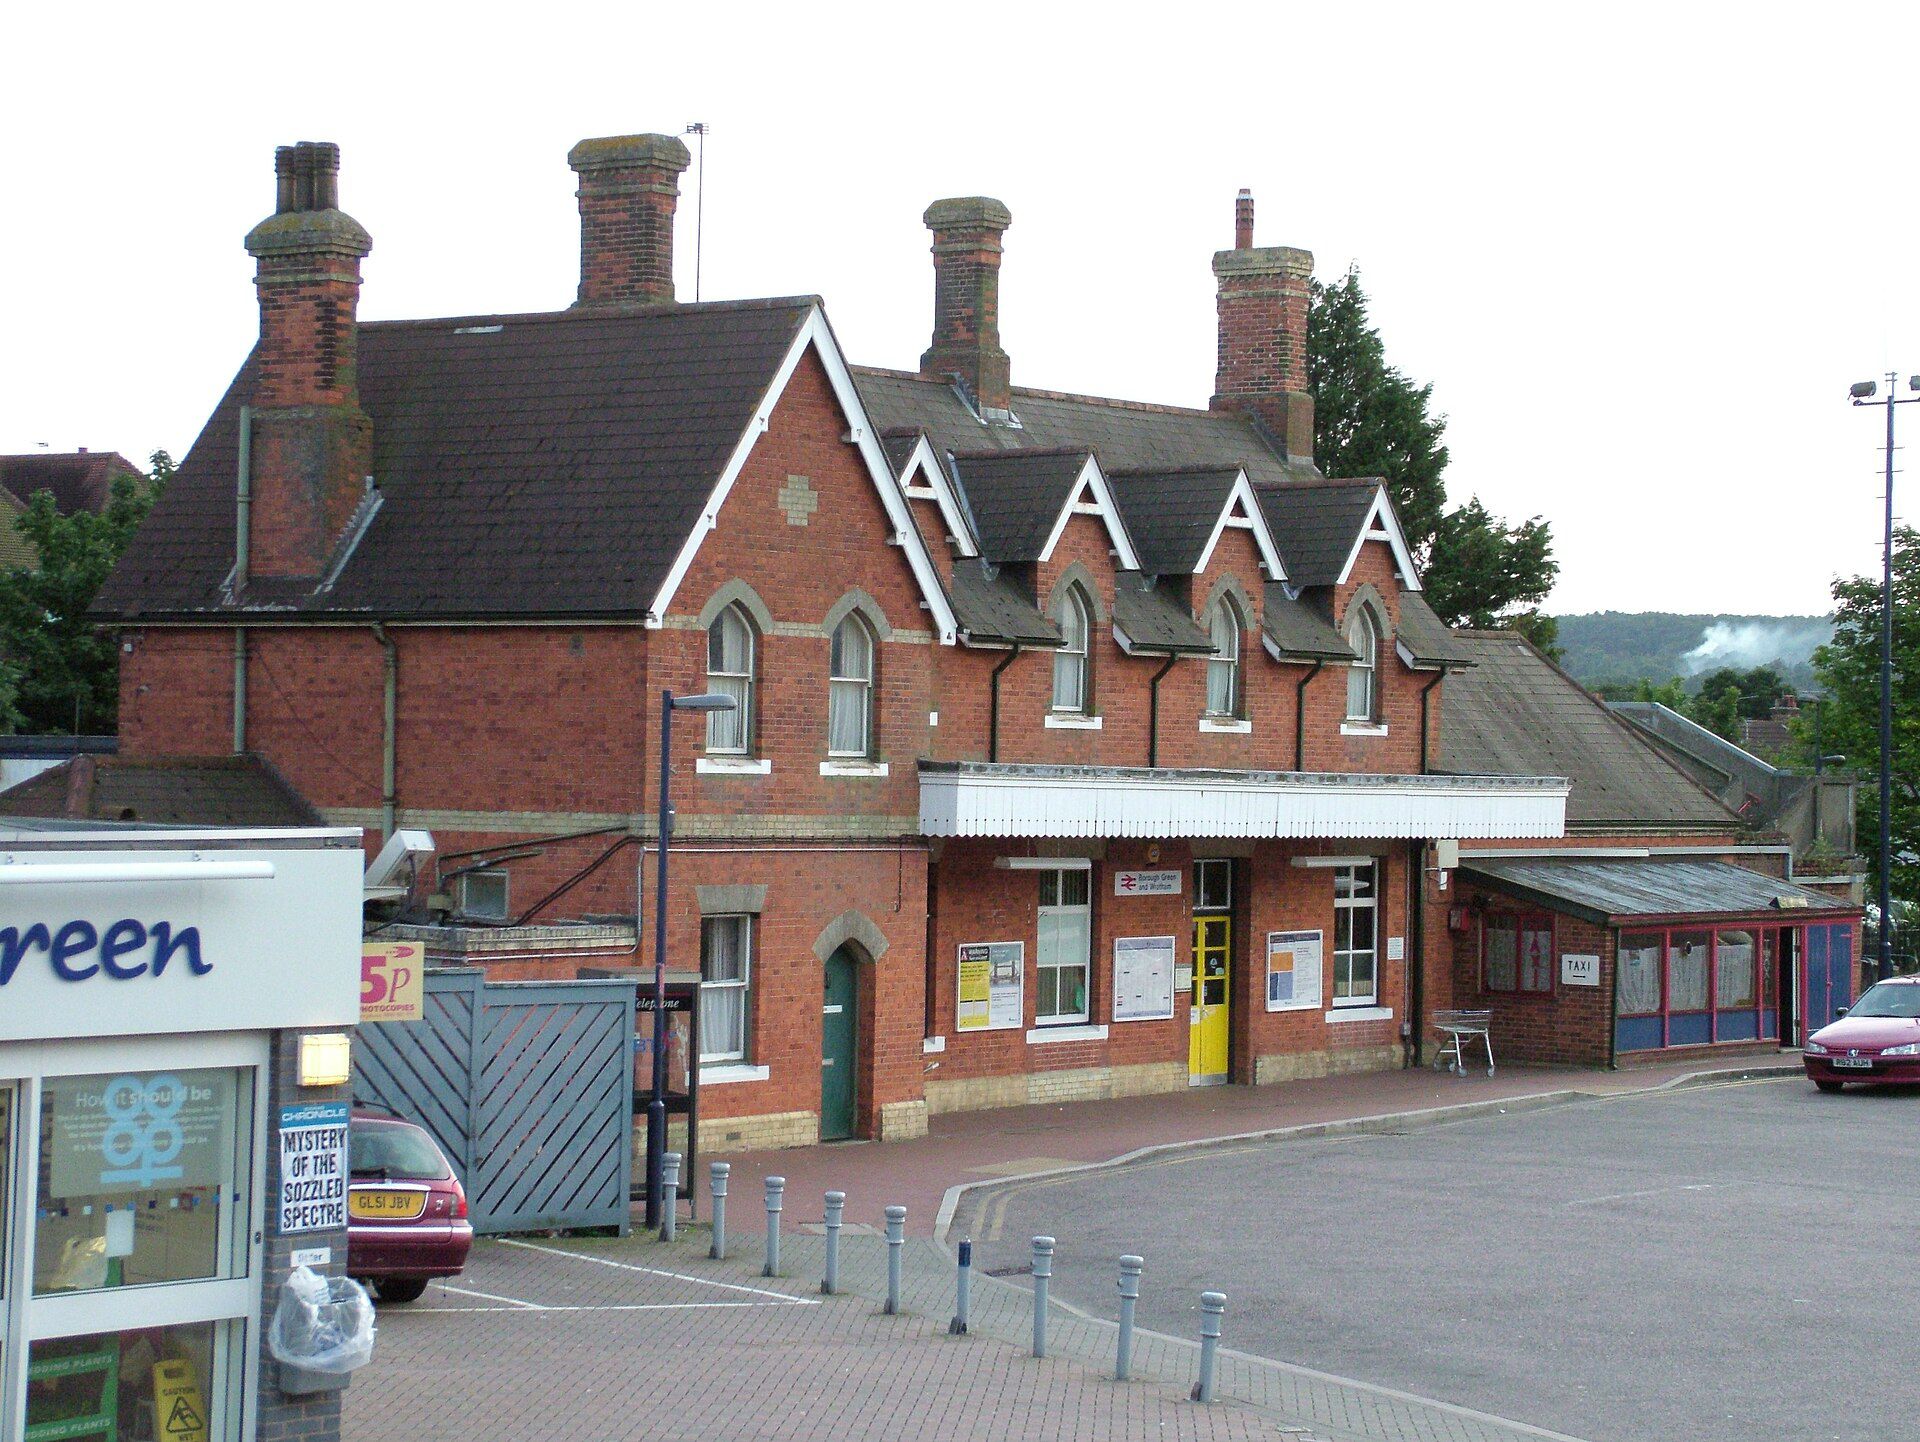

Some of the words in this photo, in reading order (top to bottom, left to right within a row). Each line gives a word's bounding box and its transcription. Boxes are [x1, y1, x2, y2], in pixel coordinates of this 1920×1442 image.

[1138, 873, 1160, 882] Borough
[1161, 873, 1177, 881] Green
[1568, 961, 1591, 972] TAXI
[361, 955, 411, 1003] 5p
[636, 997, 680, 1010] elepone
[190, 1086, 212, 1101] be
[282, 1108, 347, 1122] CHRONICLE
[284, 1129, 345, 1153] MYSTERY
[292, 1156, 308, 1178] OF
[313, 1153, 336, 1176] THE
[284, 1178, 343, 1203] SOZZLED
[283, 1202, 343, 1229] SPECTRE
